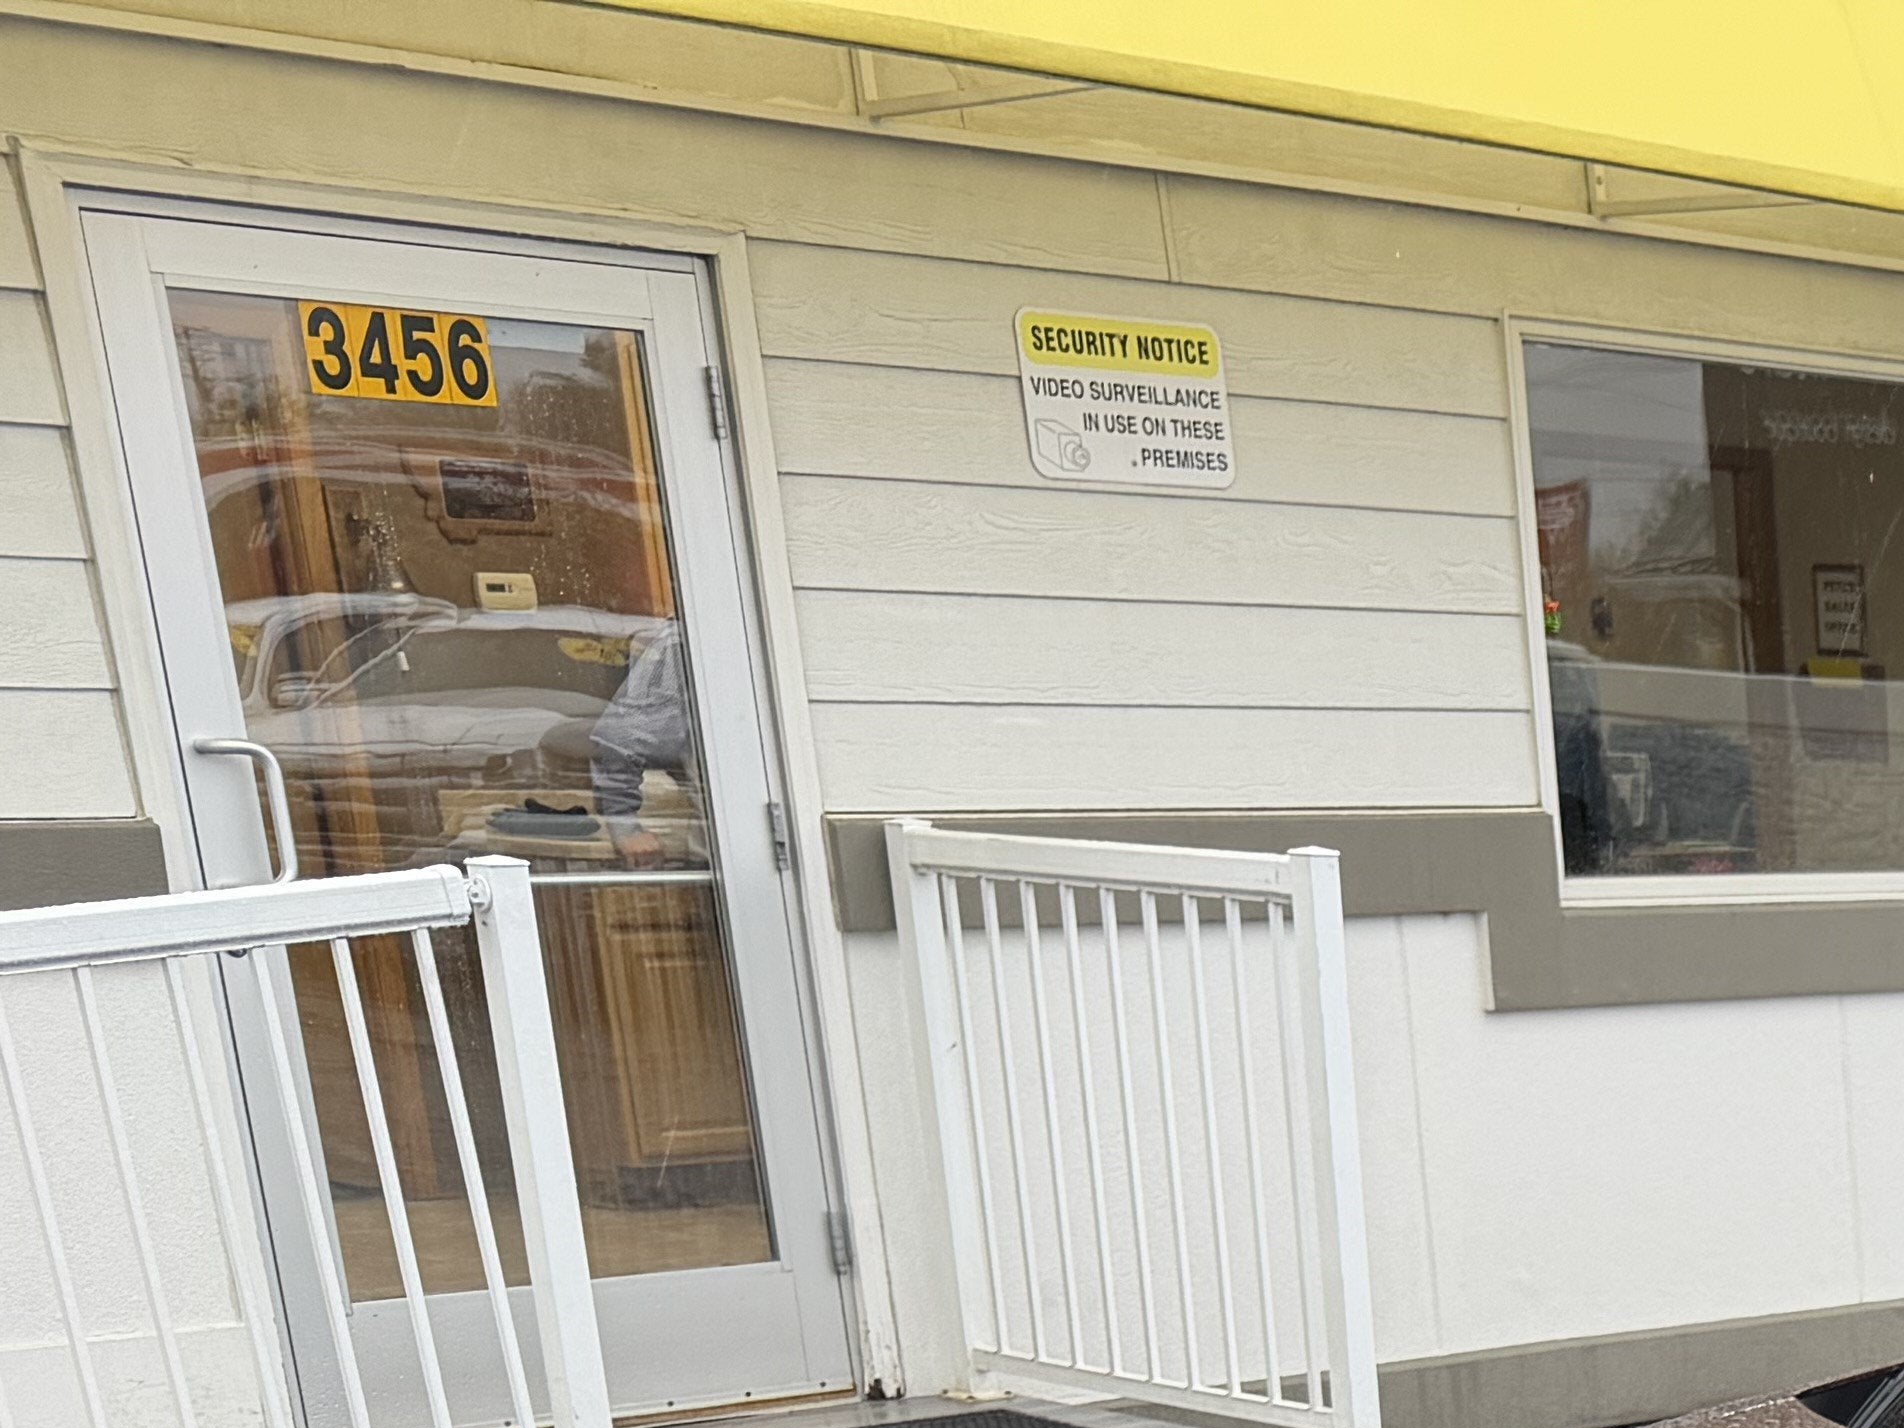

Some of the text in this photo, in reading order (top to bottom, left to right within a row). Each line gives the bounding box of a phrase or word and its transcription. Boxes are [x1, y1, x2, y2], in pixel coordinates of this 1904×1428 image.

[307, 306, 490, 401] 3456
[1031, 325, 1210, 366] SECURITY NOTICE
[1030, 376, 1222, 410] VIDEO SURVEILLANCE
[1083, 412, 1225, 441] IN USE ON THESE
[1141, 448, 1229, 472] PREMISES
